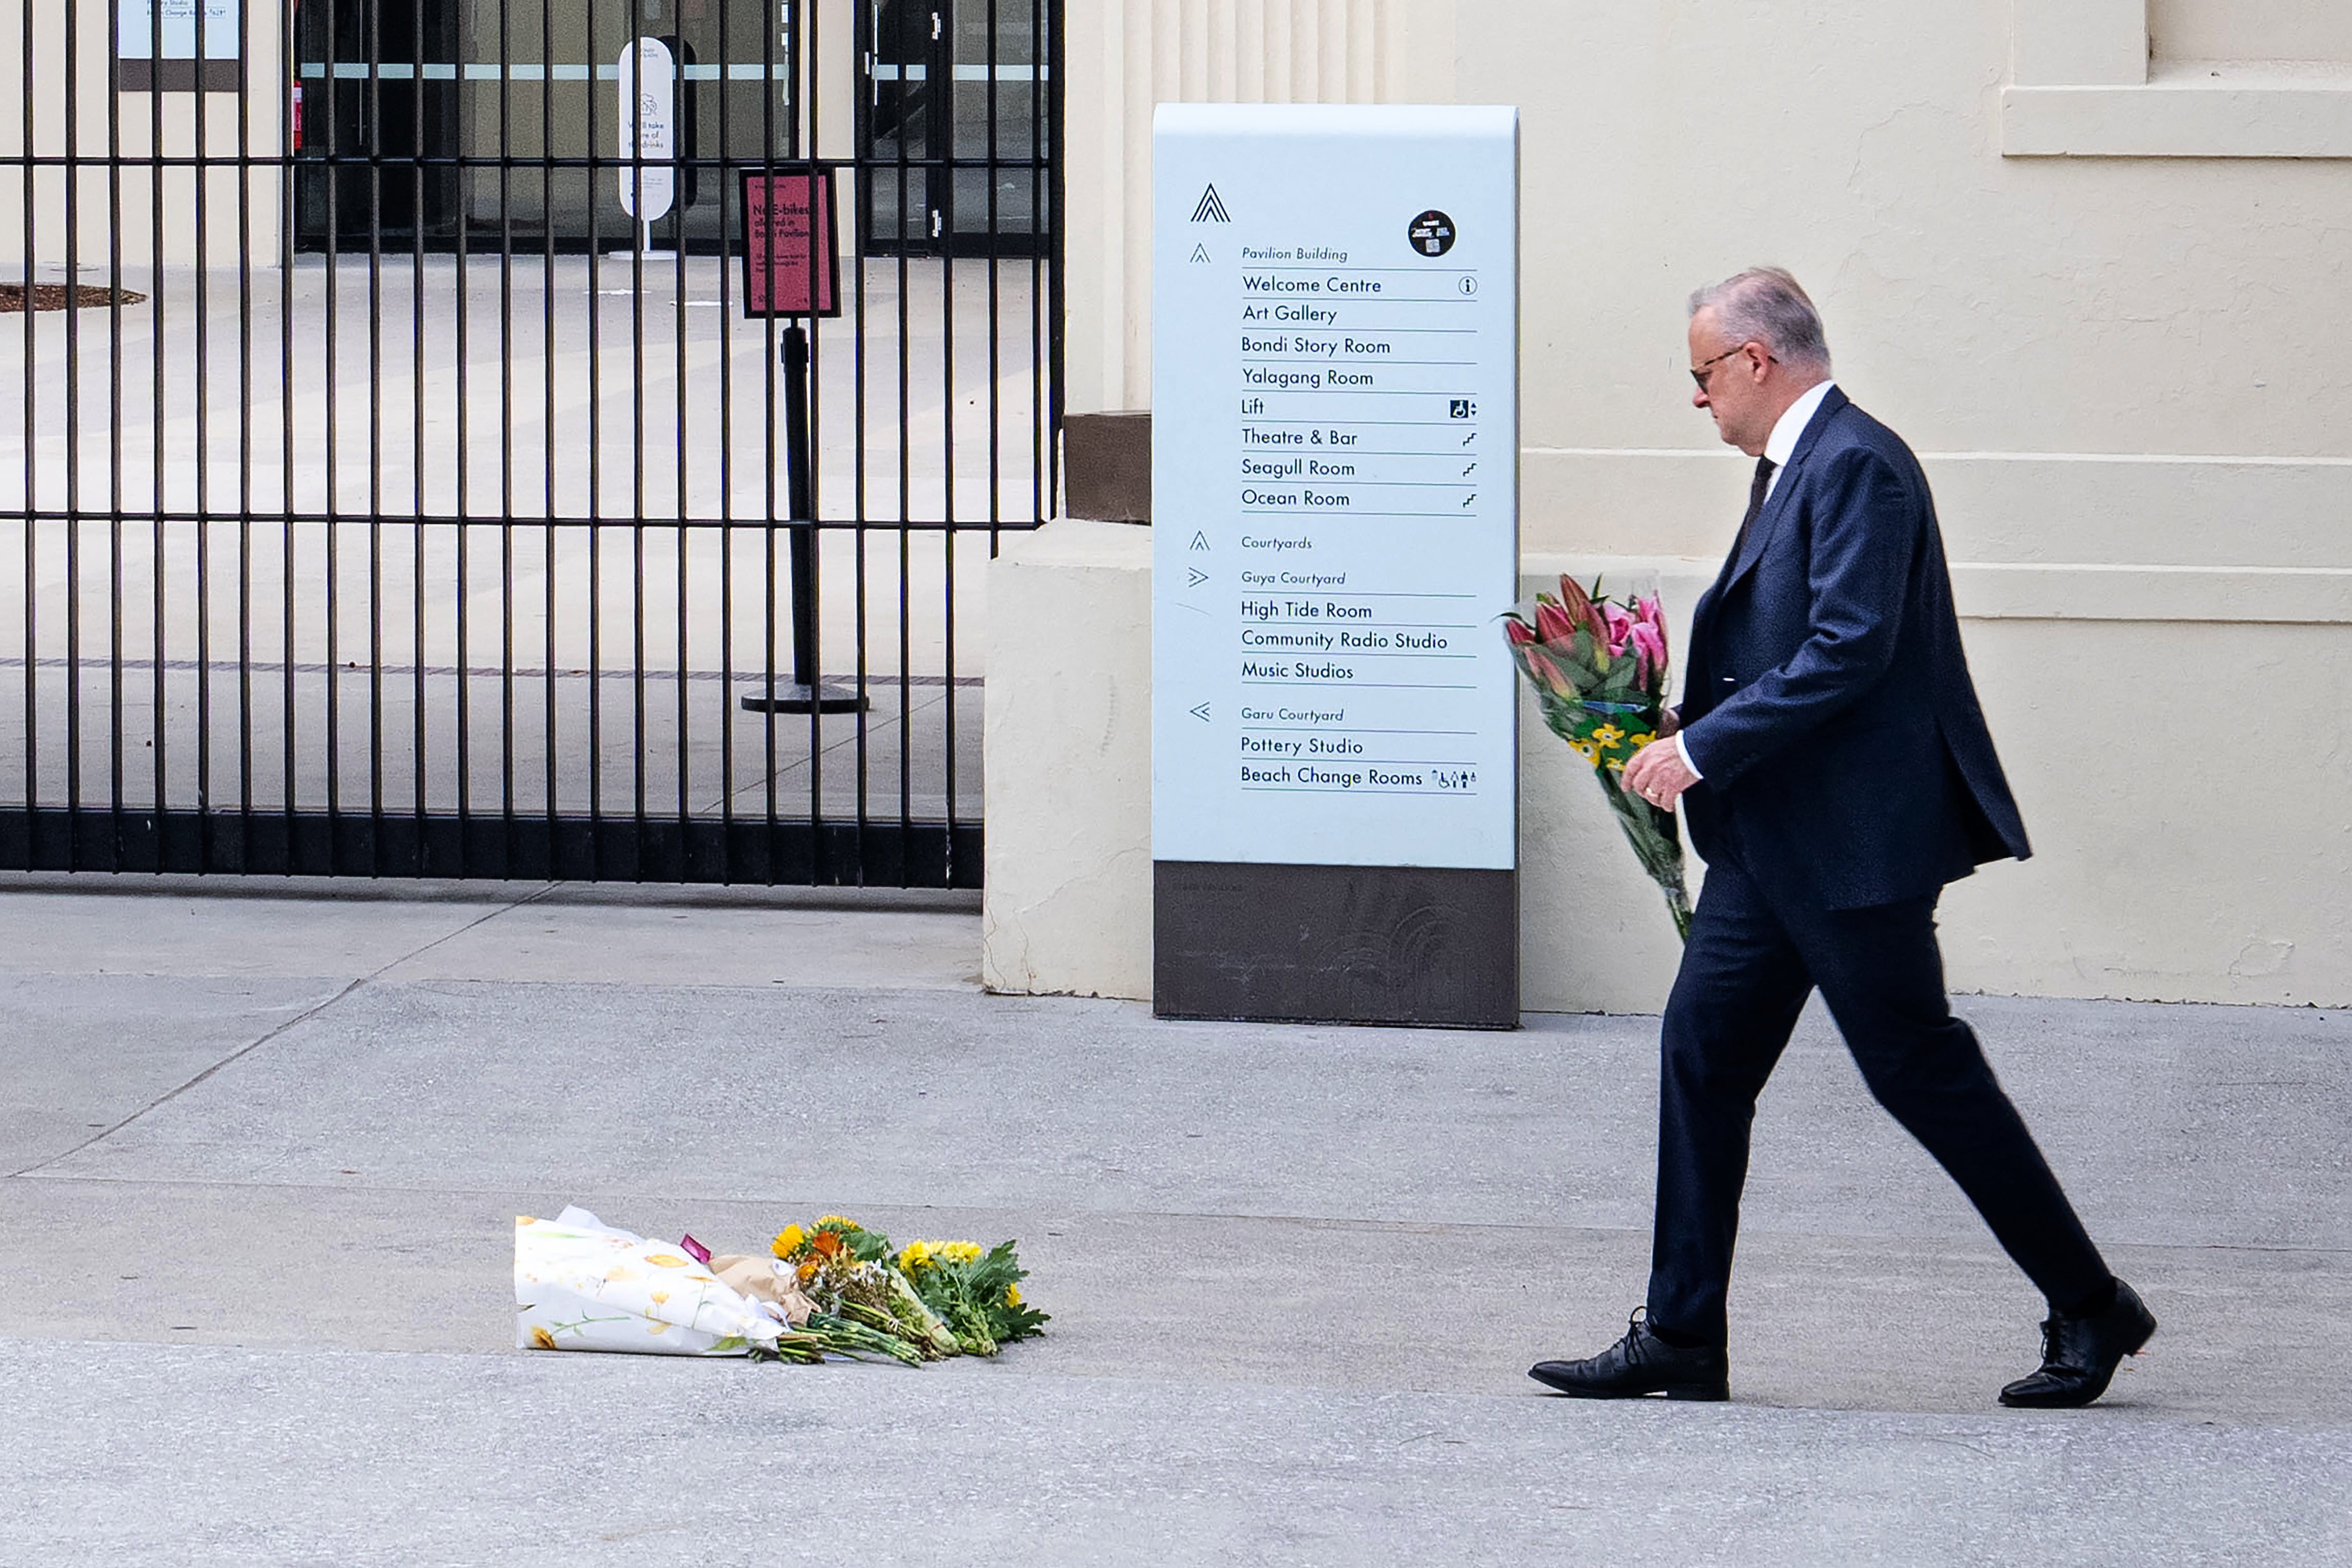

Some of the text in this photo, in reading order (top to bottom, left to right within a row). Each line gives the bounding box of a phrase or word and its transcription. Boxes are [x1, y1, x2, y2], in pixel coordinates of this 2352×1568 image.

[773, 202, 809, 215] E-bikes
[1242, 246, 1348, 263] Pavilion Building
[1243, 275, 1381, 293] Welcome Centre
[1243, 304, 1337, 326] Art Gallery
[1242, 336, 1390, 358] Bondi Story Room
[1243, 367, 1373, 389] Yalagang Room
[1242, 398, 1264, 414] Lift
[1242, 427, 1358, 445] Theatre & Bar
[1242, 458, 1355, 479] Seagull Room
[1241, 489, 1350, 506] Ocean Room
[1241, 536, 1312, 552] Courtyards
[1241, 571, 1346, 588] Guya Courtyard
[1241, 600, 1372, 621] High Tide Room
[1242, 630, 1447, 651] Community Radio Studio
[1242, 661, 1354, 679] Music Studios
[1241, 707, 1344, 724] Garu Courtyard
[1241, 737, 1363, 757] Pottery Studio
[1241, 766, 1422, 788] Beach Change Rooms
